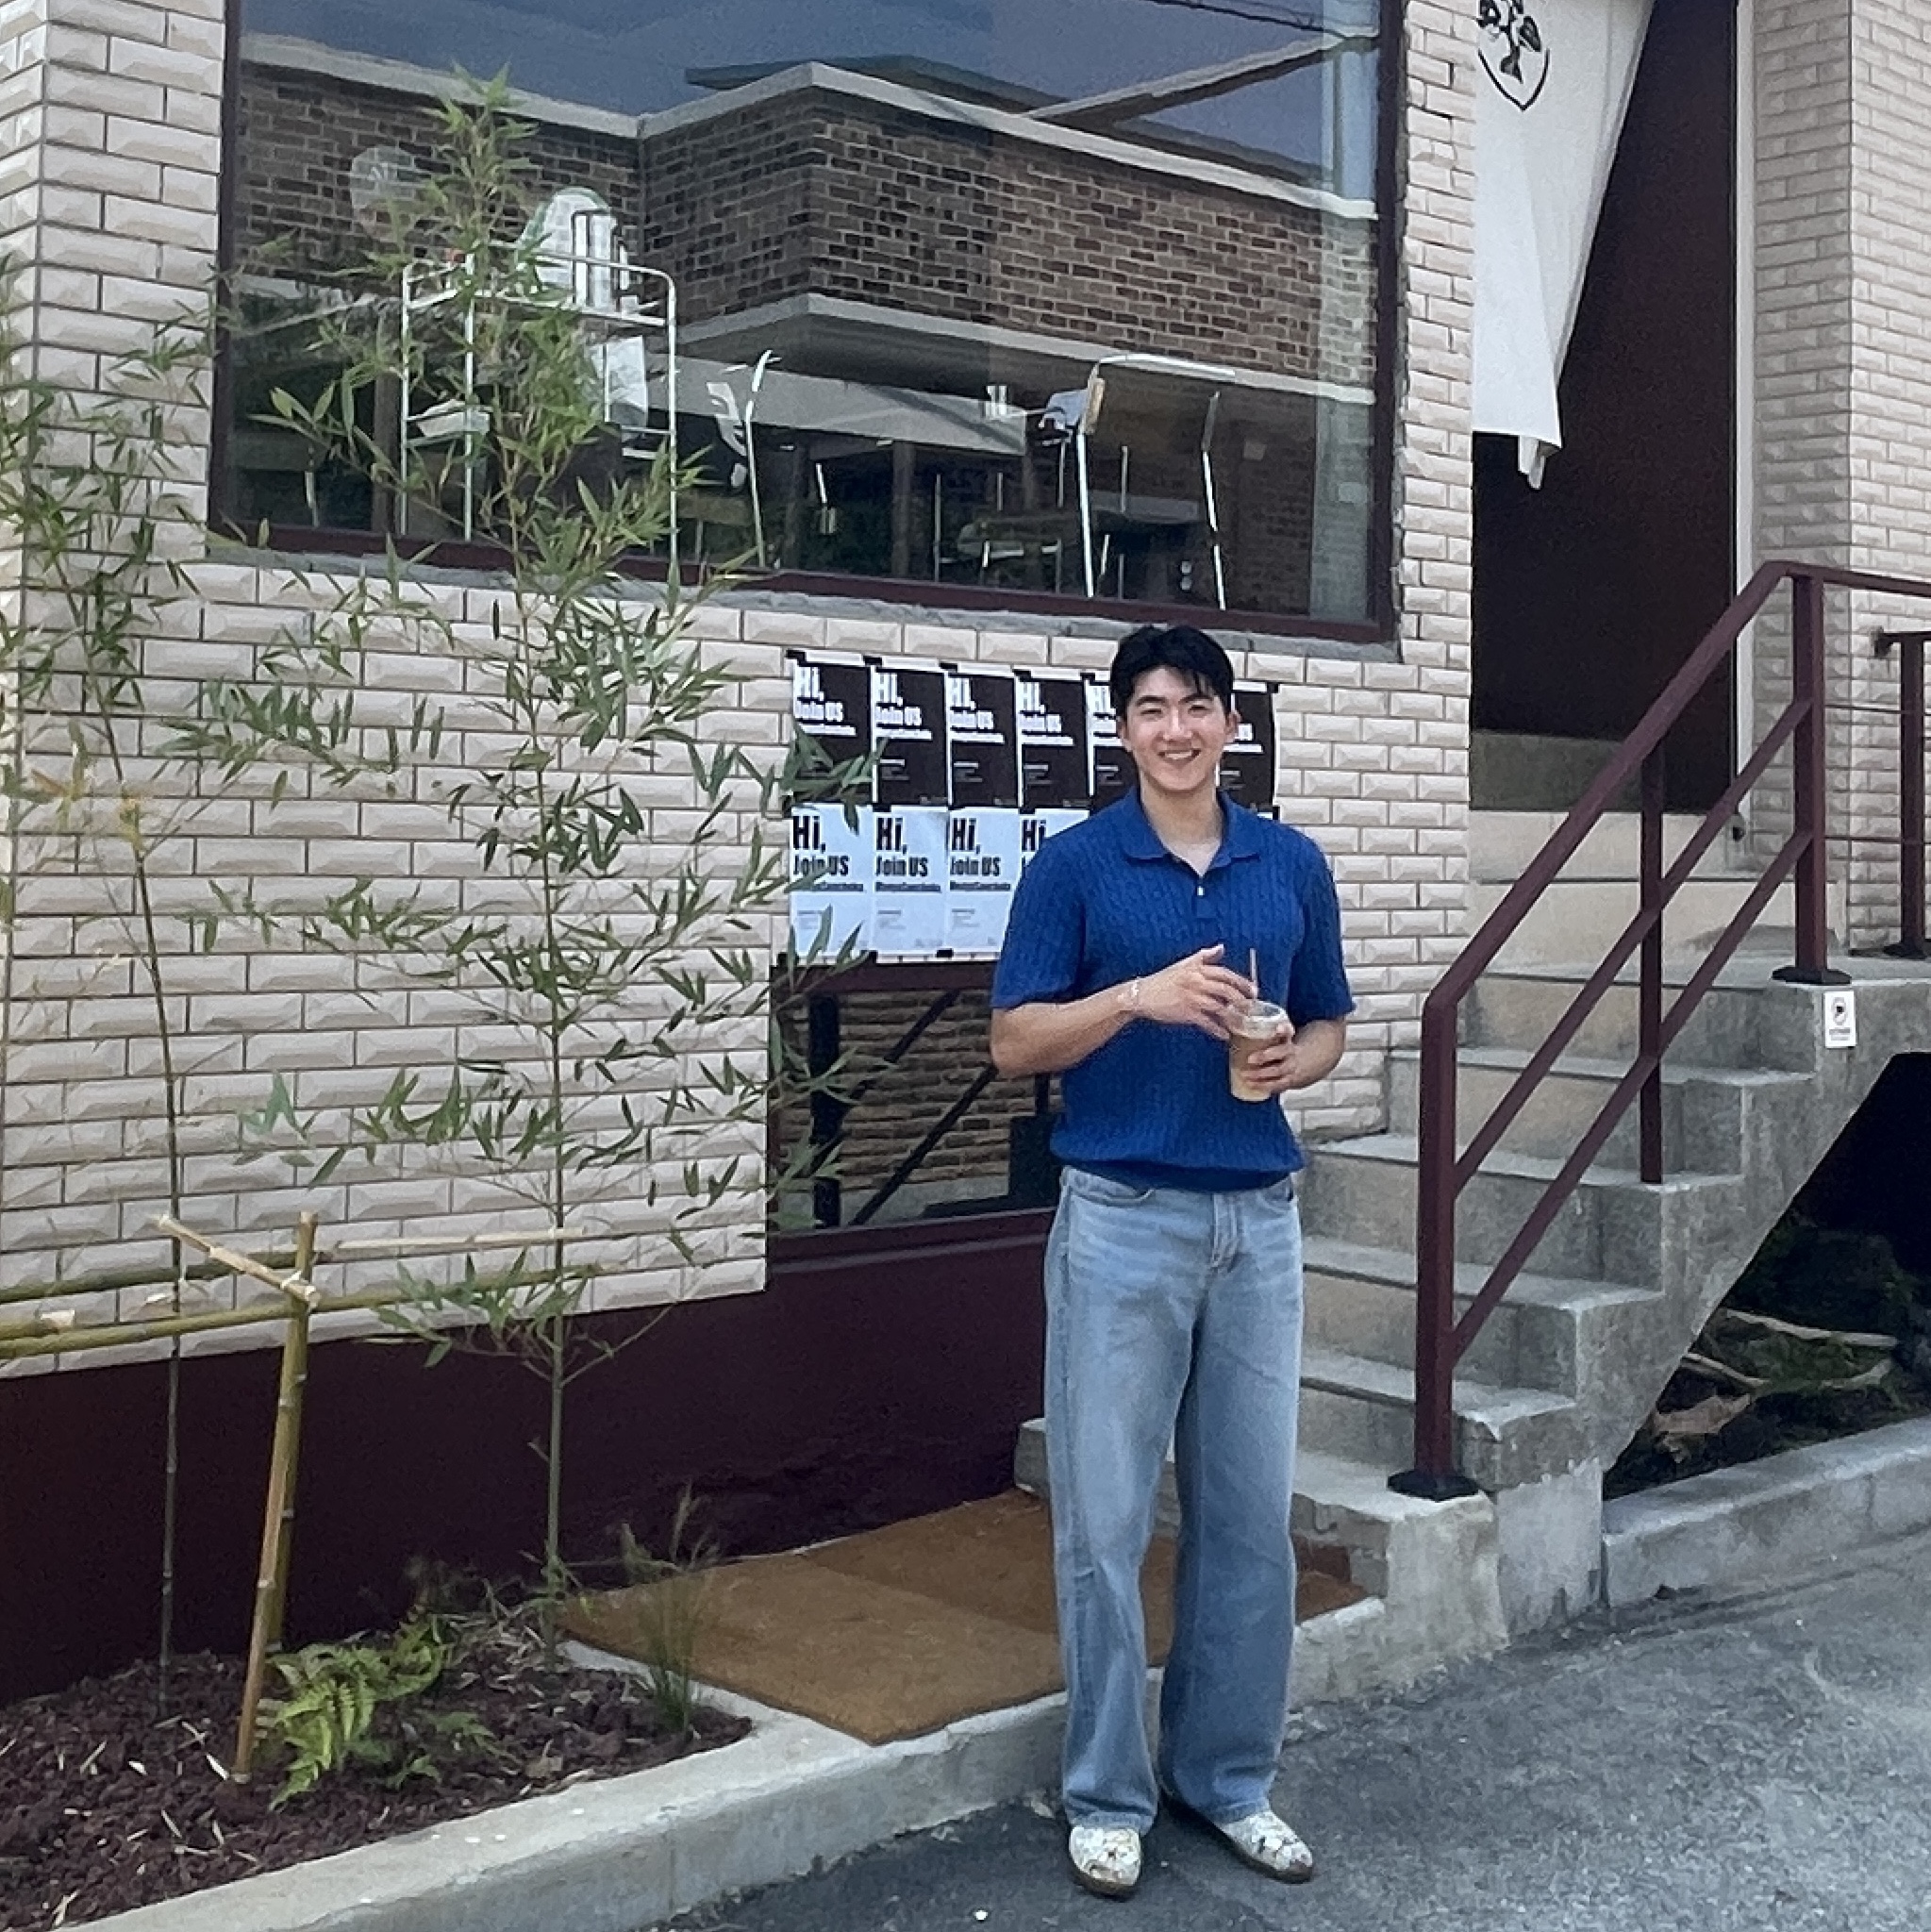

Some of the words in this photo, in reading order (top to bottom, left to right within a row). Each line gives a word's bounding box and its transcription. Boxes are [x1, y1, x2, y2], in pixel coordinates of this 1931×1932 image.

[874, 673, 903, 707] Hi,
[947, 678, 976, 710] Hi,
[1017, 683, 1045, 714] Hi,
[793, 815, 825, 854] Hi,
[876, 817, 907, 856] Hi,
[951, 818, 981, 855] Hi,
[1022, 819, 1046, 854] Hi
[827, 855, 850, 877] US
[875, 856, 907, 877] Join
[908, 857, 928, 877] US
[950, 856, 979, 876] Join
[981, 856, 1002, 877] US
